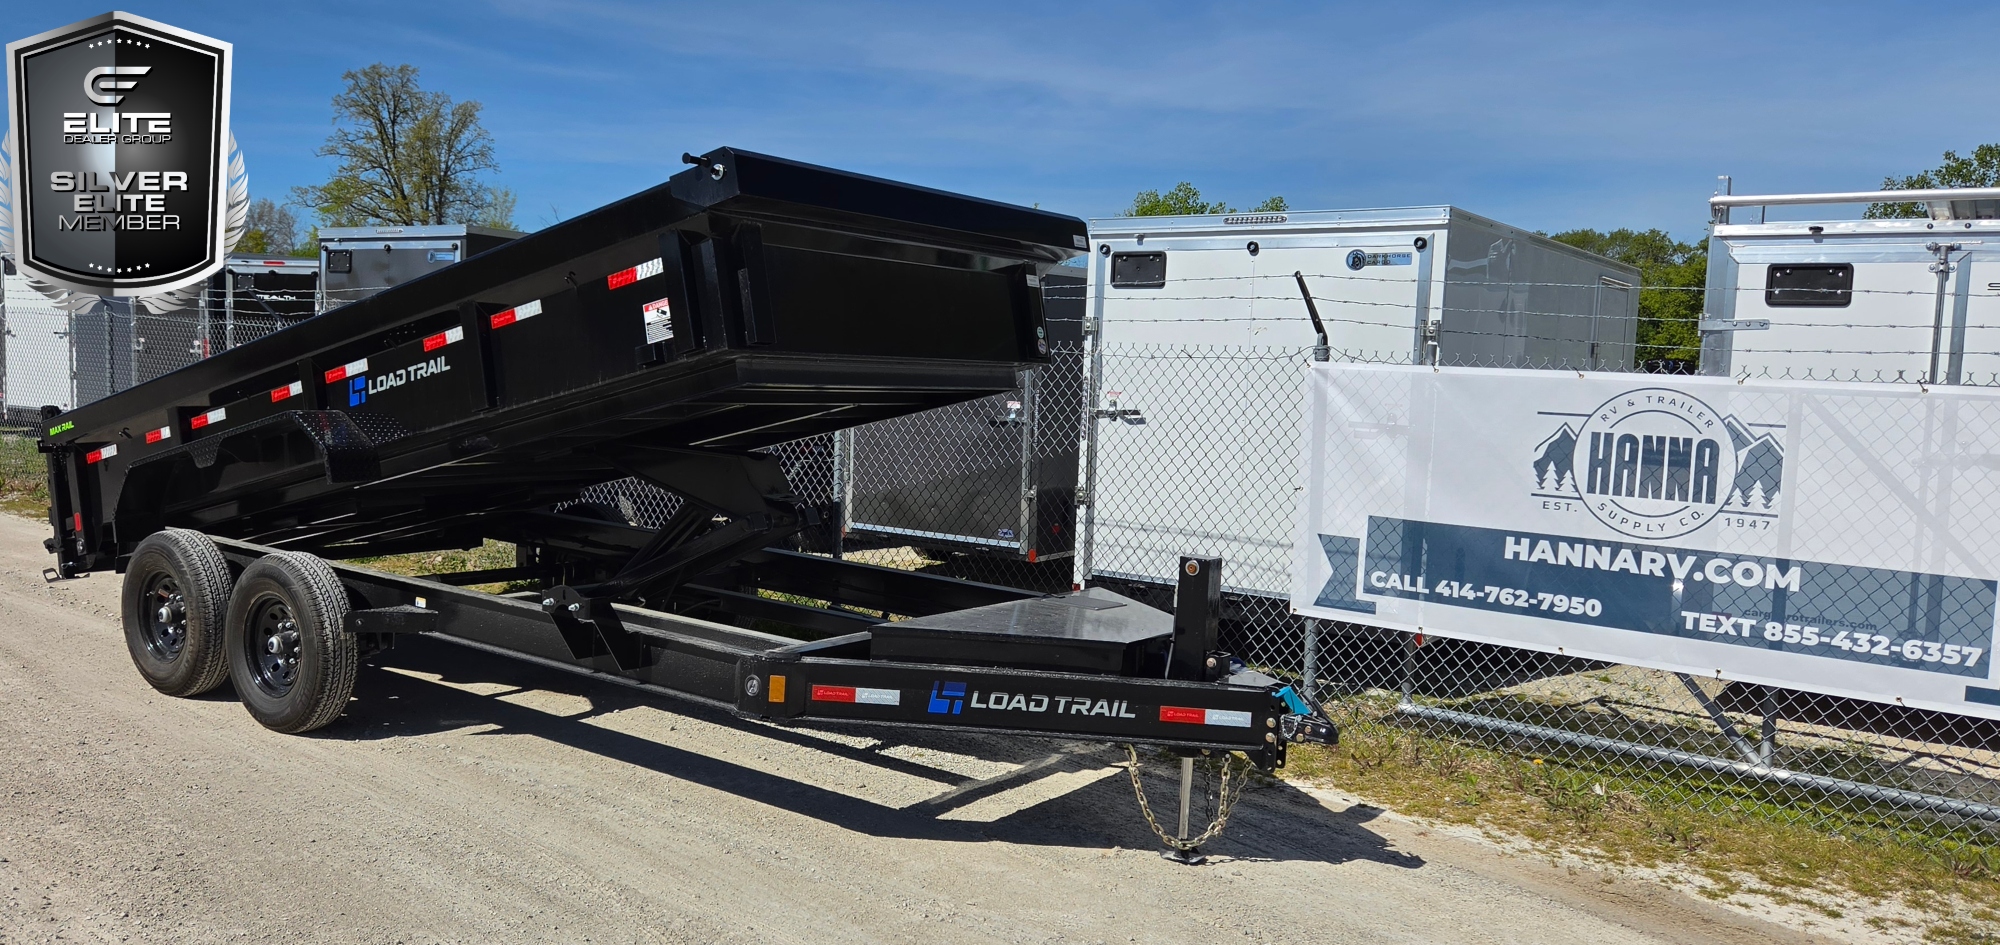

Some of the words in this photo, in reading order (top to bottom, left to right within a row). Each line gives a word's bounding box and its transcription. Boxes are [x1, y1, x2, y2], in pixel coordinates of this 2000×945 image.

[368, 371, 406, 394] LOAD
[407, 356, 450, 381] TRAIL
[1600, 406, 1618, 423] RV
[1627, 398, 1635, 407] &
[1645, 395, 1715, 429] TRAILER
[50, 425, 61, 436] MAX
[1586, 431, 1721, 505] HANNA
[1542, 500, 1578, 513] EST.
[1597, 502, 1666, 533] SUPPLY
[1679, 512, 1705, 527] CO.
[1724, 517, 1771, 530] 1947
[1504, 536, 1800, 592] HANNARV.COM
[1370, 571, 1430, 594] CALL
[1435, 580, 1603, 618] 414-762-7950
[1744, 609, 1878, 631] cargrotrailers.com
[1680, 610, 1757, 637] TEXT
[1763, 621, 1983, 668] 855-432-6357
[970, 690, 1049, 713] LOAD
[1054, 695, 1136, 719] TRAIL
